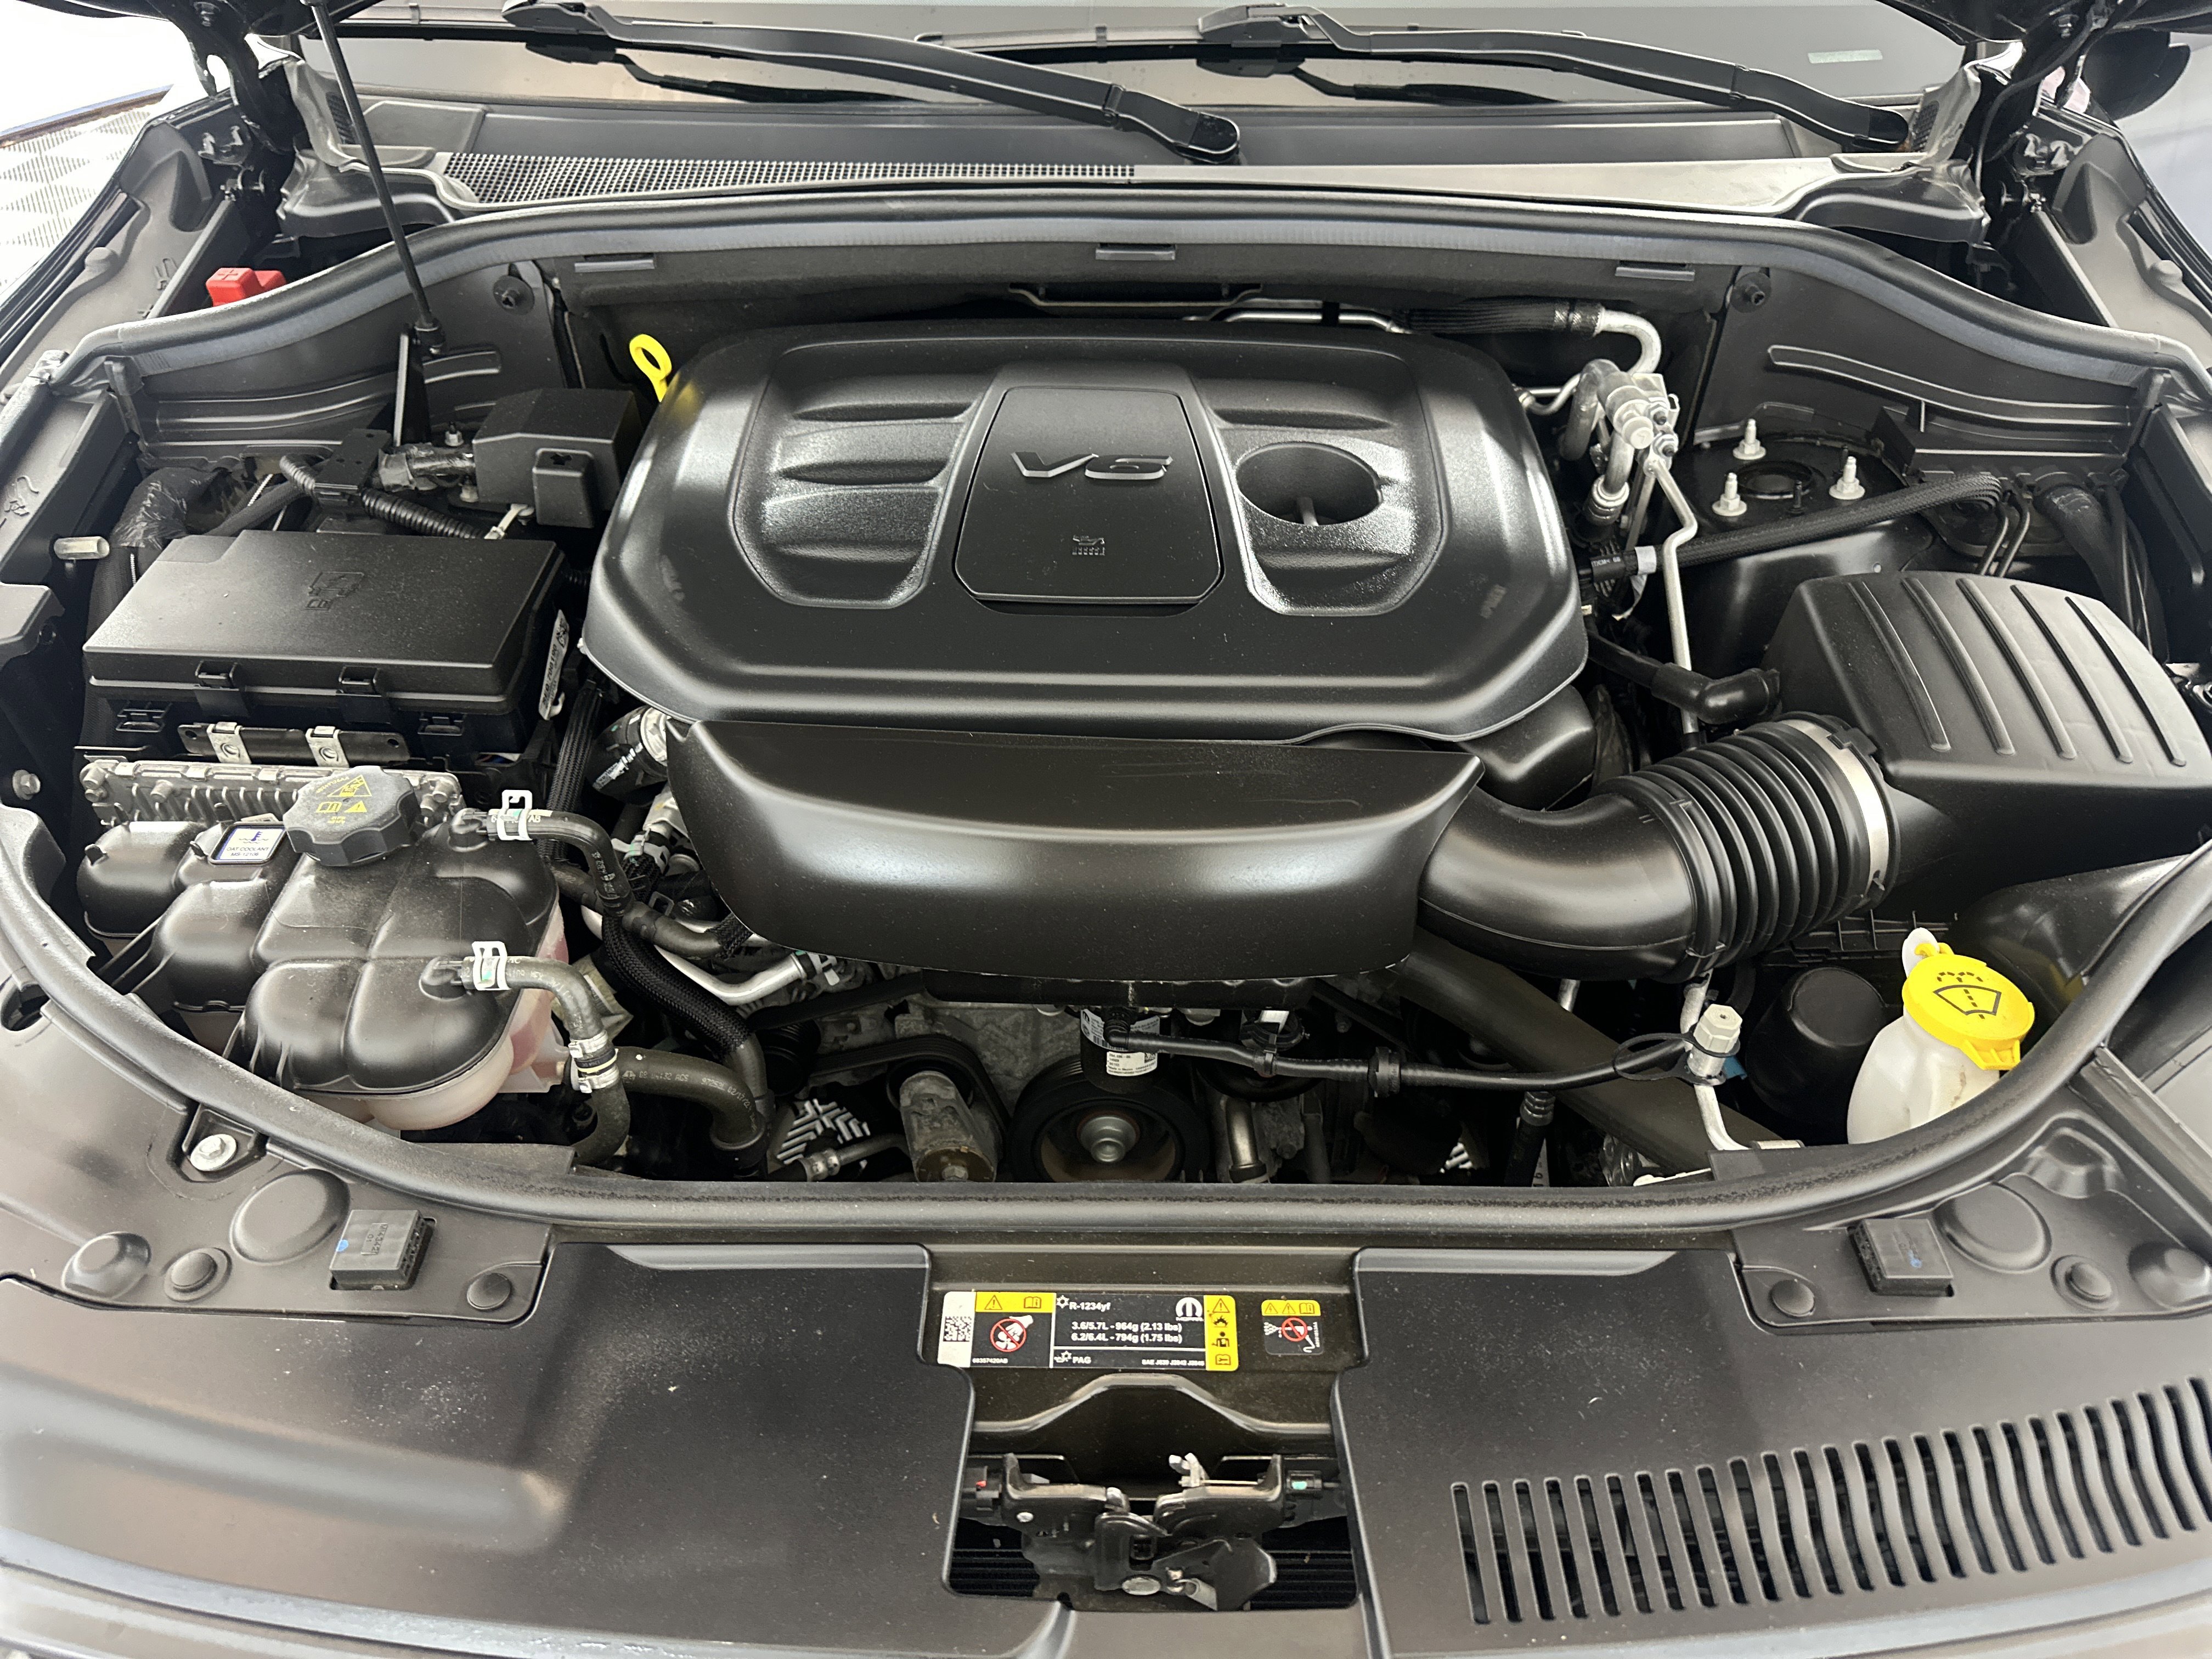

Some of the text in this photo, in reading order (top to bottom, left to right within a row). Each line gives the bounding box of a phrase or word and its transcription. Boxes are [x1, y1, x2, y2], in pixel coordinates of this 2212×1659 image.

[1011, 451, 1173, 480] V6
[1069, 1302, 1111, 1312] R-1234yf
[1071, 1322, 1108, 1330] 3.6/5.7L
[1115, 1322, 1139, 1332] 964g
[1140, 1322, 1163, 1332] (2.13
[1164, 1323, 1182, 1333] lbs)
[1071, 1333, 1108, 1341] 6.2/6.4L
[1115, 1333, 1139, 1344] 794g
[1140, 1334, 1163, 1344] (1.75
[1164, 1334, 1182, 1344] lbs)
